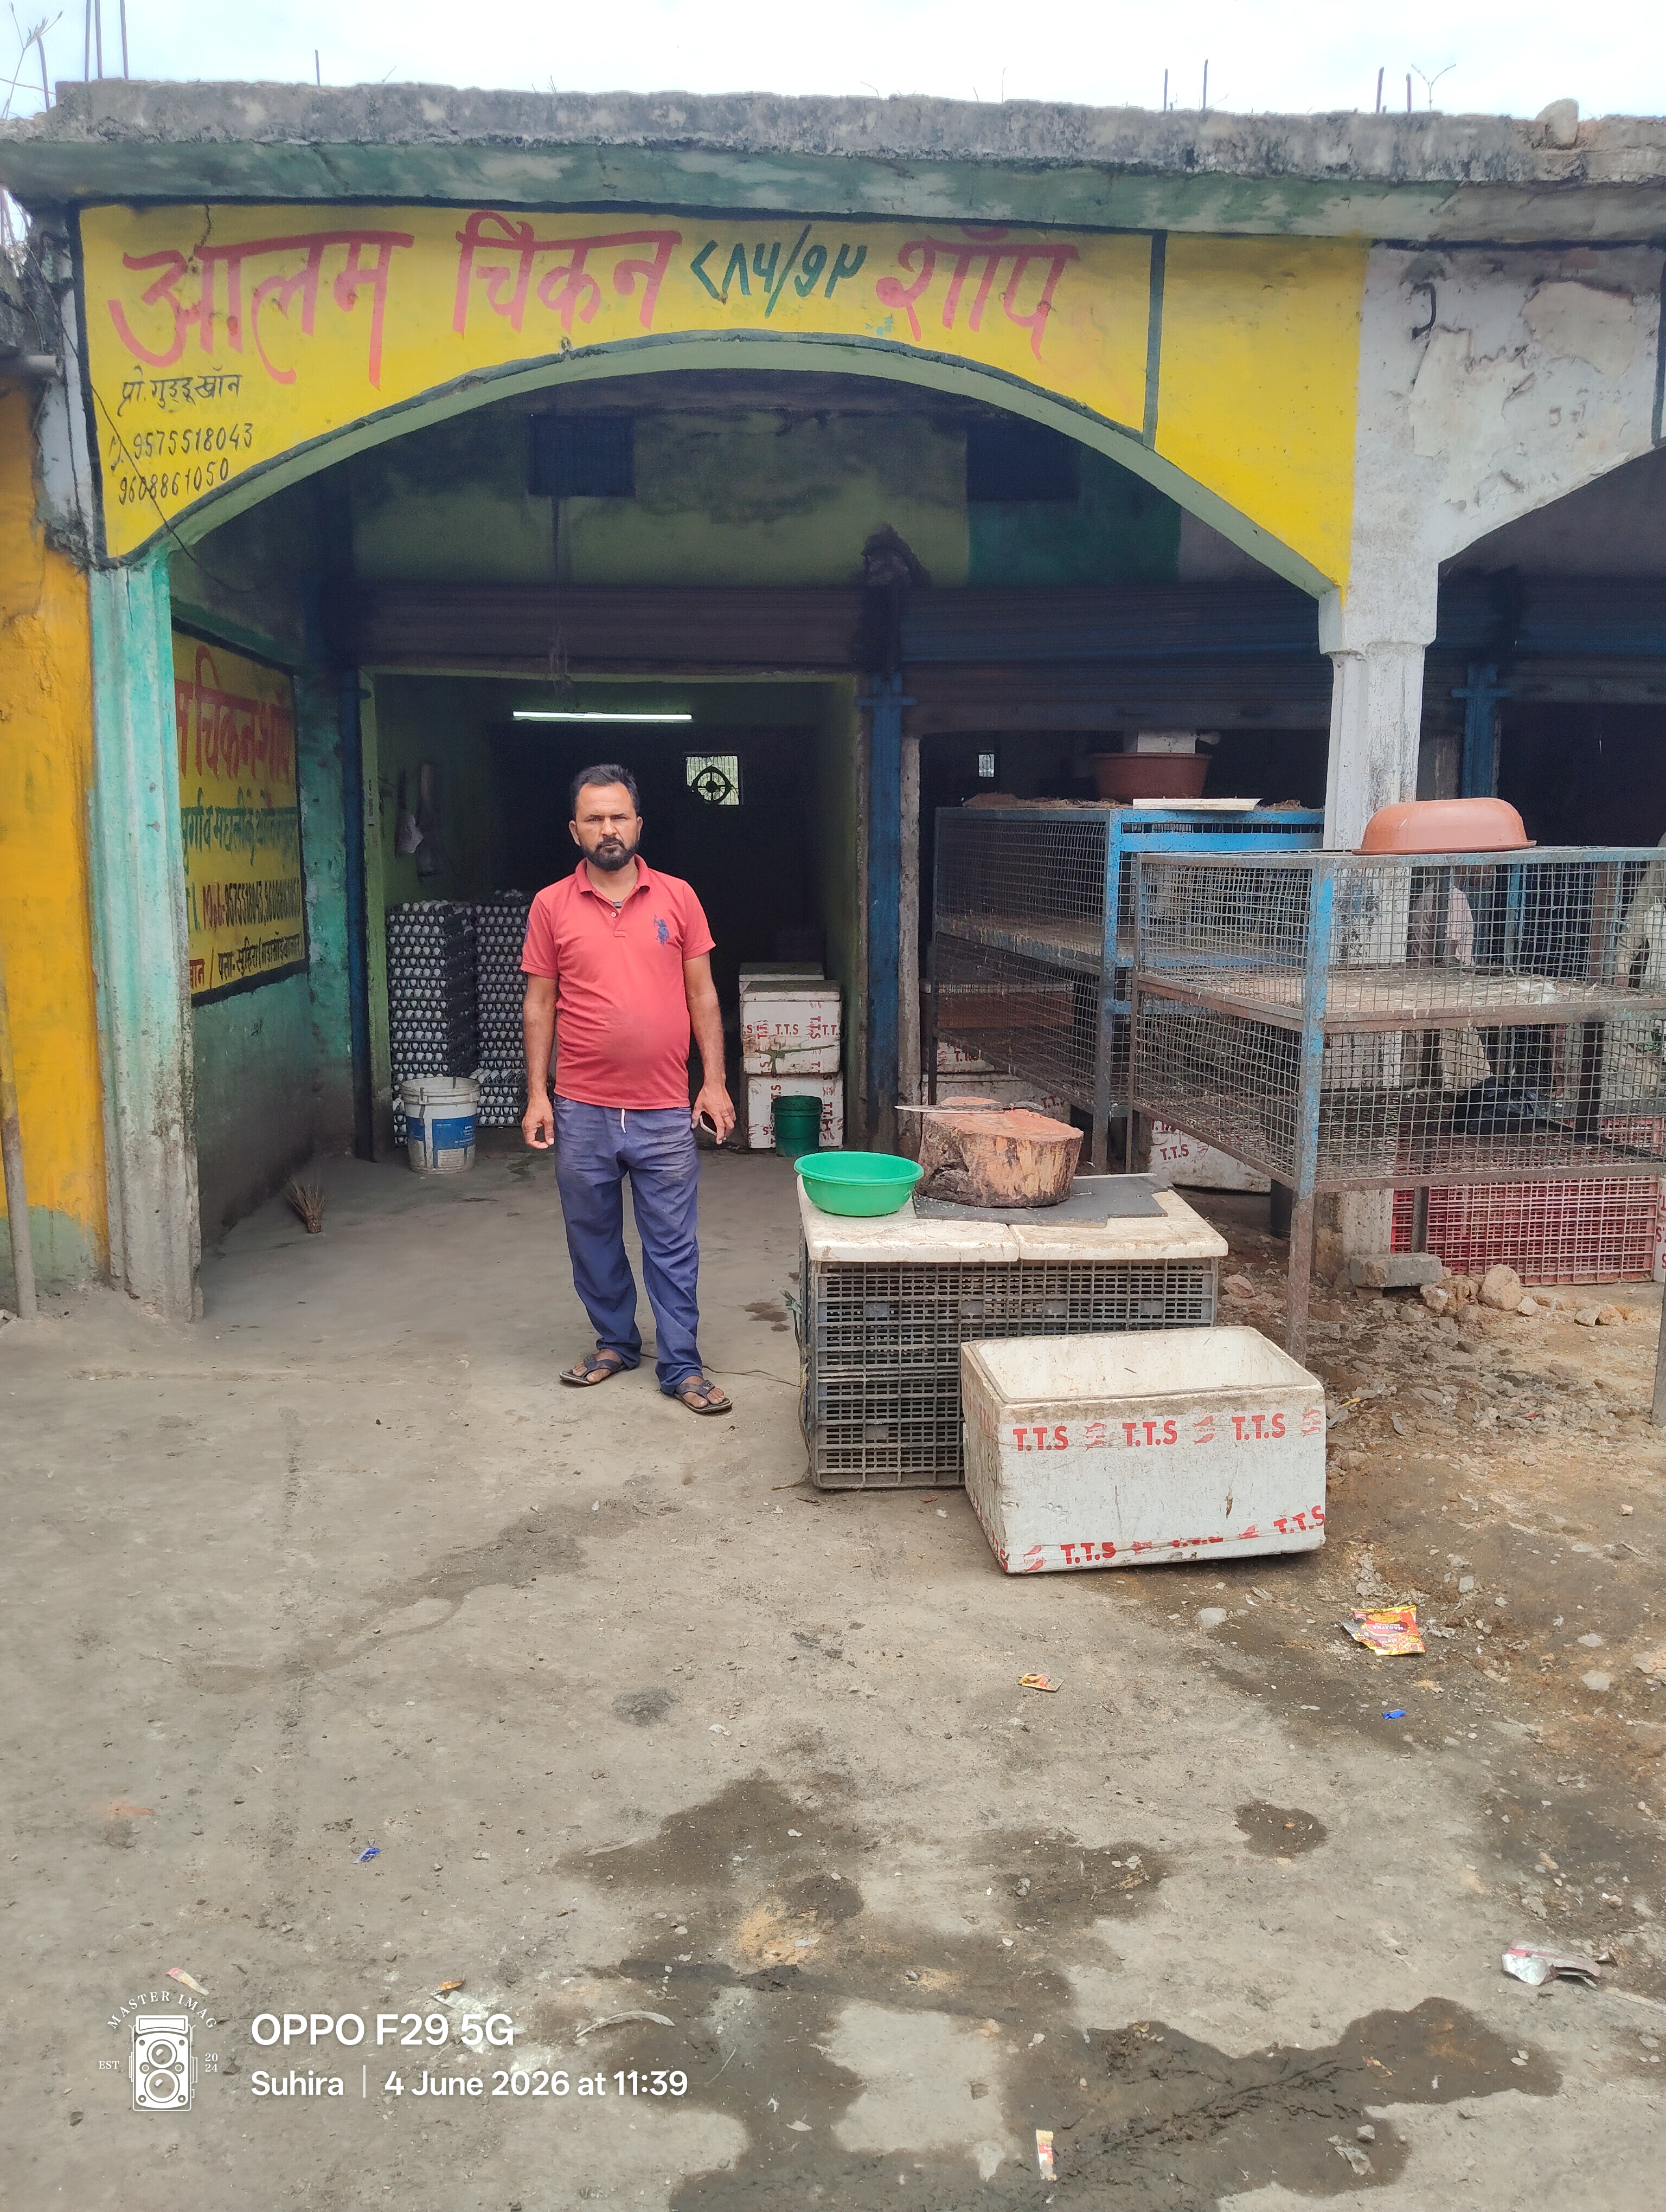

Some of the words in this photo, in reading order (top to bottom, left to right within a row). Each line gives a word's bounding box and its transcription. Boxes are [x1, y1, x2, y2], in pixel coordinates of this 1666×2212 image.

[107, 230, 414, 391] आलम
[876, 226, 1079, 362] शॉप
[133, 423, 253, 459] 9575518043
[119, 458, 229, 505] 9608861050
[776, 1024, 799, 1035] T.T.S
[822, 1024, 838, 1036] T.T.
[1160, 1144, 1189, 1161] T.T.S
[1013, 1426, 1068, 1451] T.T.S
[1122, 1420, 1178, 1447] T.T.S
[1232, 1413, 1286, 1441] T.T.S
[1060, 1541, 1117, 1565] T.T.S
[1273, 1505, 1325, 1534] T.T.S
